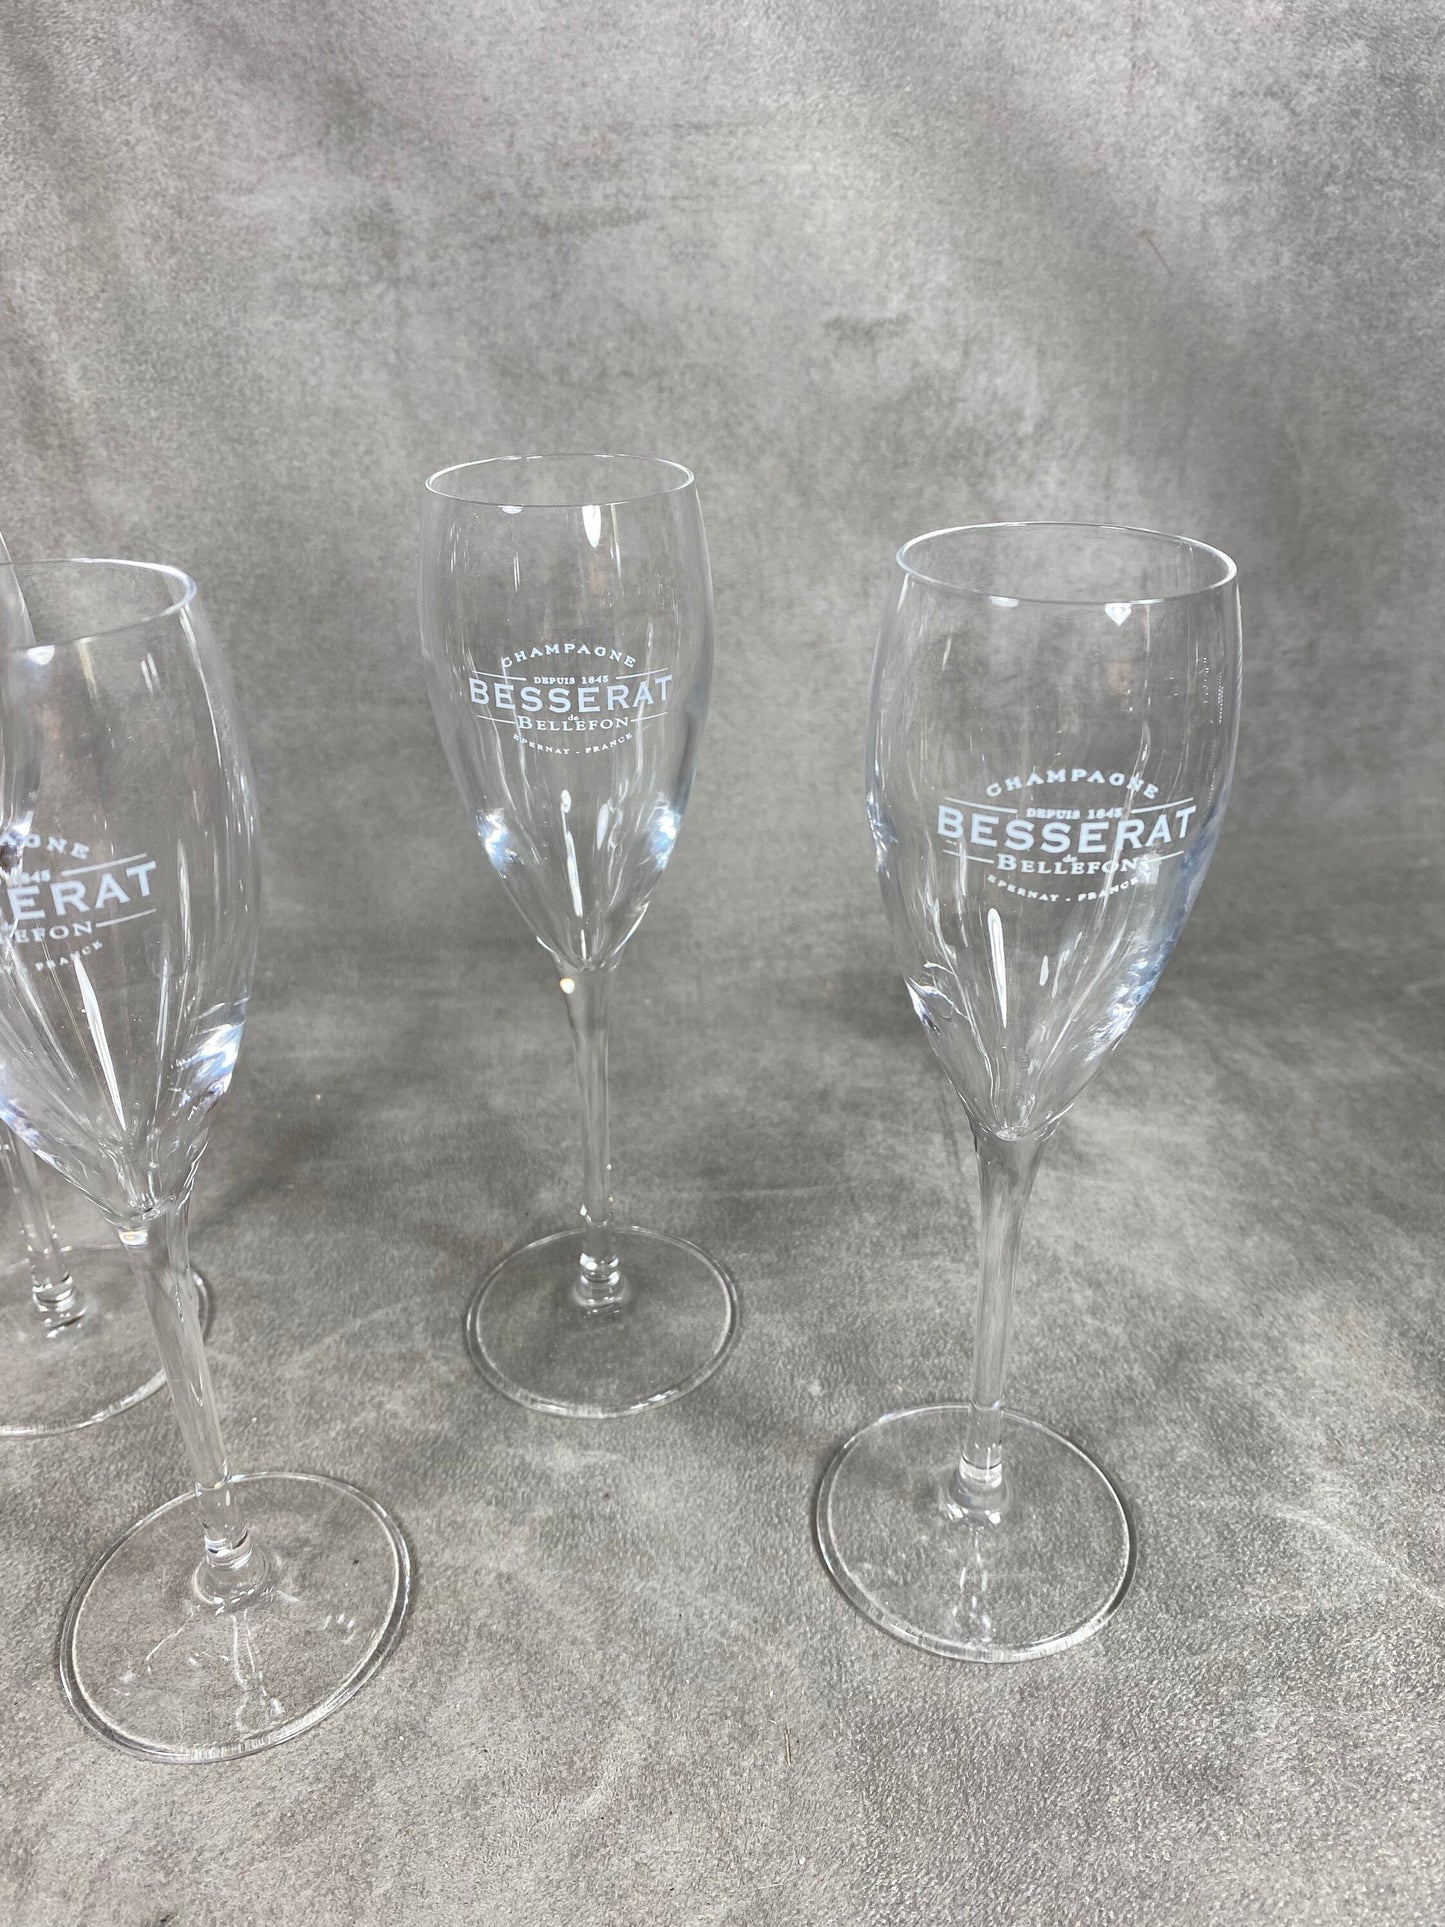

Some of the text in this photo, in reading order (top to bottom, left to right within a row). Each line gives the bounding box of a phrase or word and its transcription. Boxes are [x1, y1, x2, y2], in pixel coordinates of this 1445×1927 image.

[502, 643, 636, 669] CHAMPAGNE
[533, 675, 609, 685] DEPUIS 1845
[468, 674, 673, 713] BESSERAT
[517, 715, 630, 731] BELLEFON
[512, 733, 570, 755] EPERNAY
[585, 732, 633, 754] FRANCE
[985, 768, 1159, 800] CHAMPAGNE
[1026, 807, 1080, 820] DEPUIS
[937, 805, 1197, 853] BESSERAT
